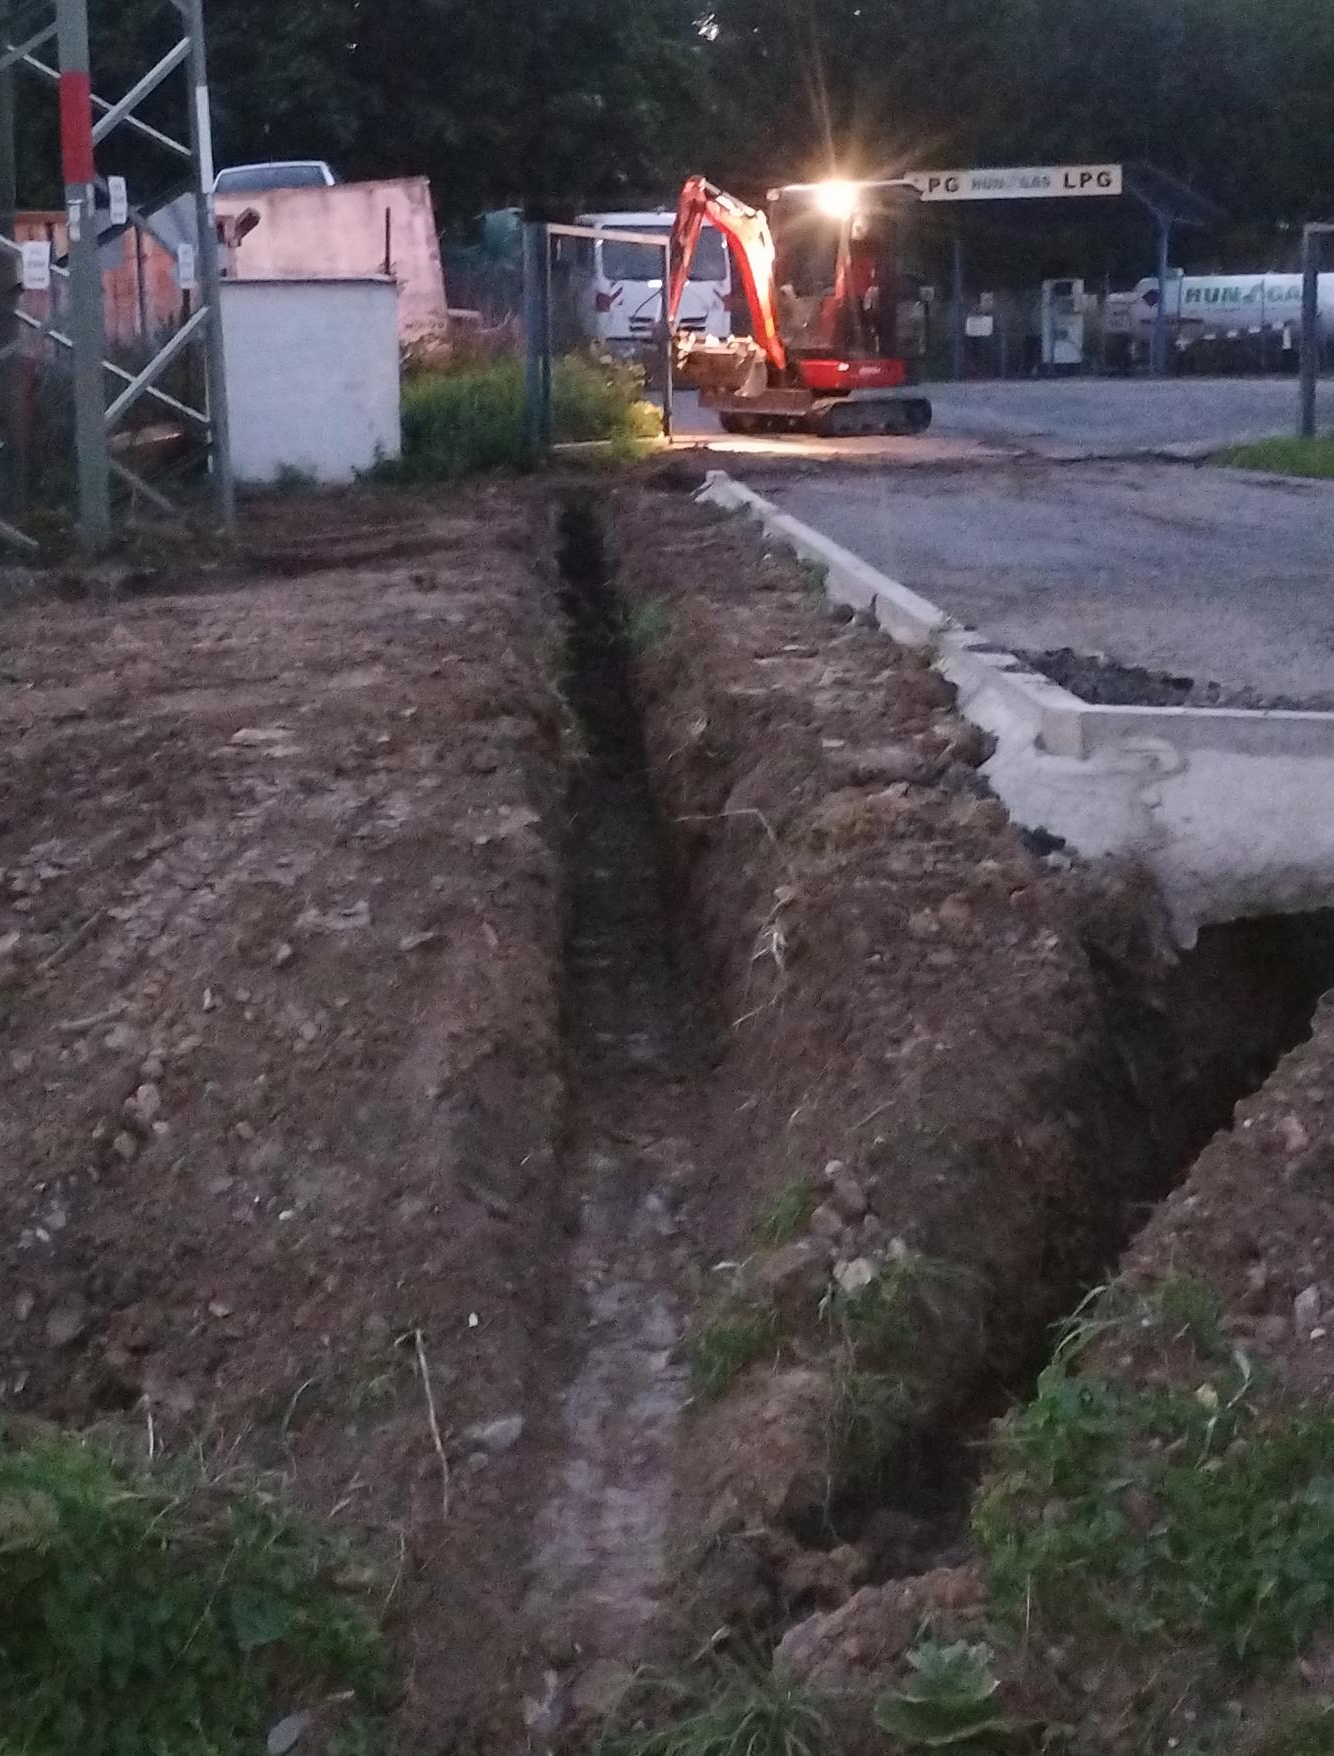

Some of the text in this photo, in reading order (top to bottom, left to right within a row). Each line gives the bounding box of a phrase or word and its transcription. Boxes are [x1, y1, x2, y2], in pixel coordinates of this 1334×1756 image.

[914, 176, 960, 193] PG
[1064, 171, 1113, 190] LPG
[1185, 285, 1301, 304] HUN GA
